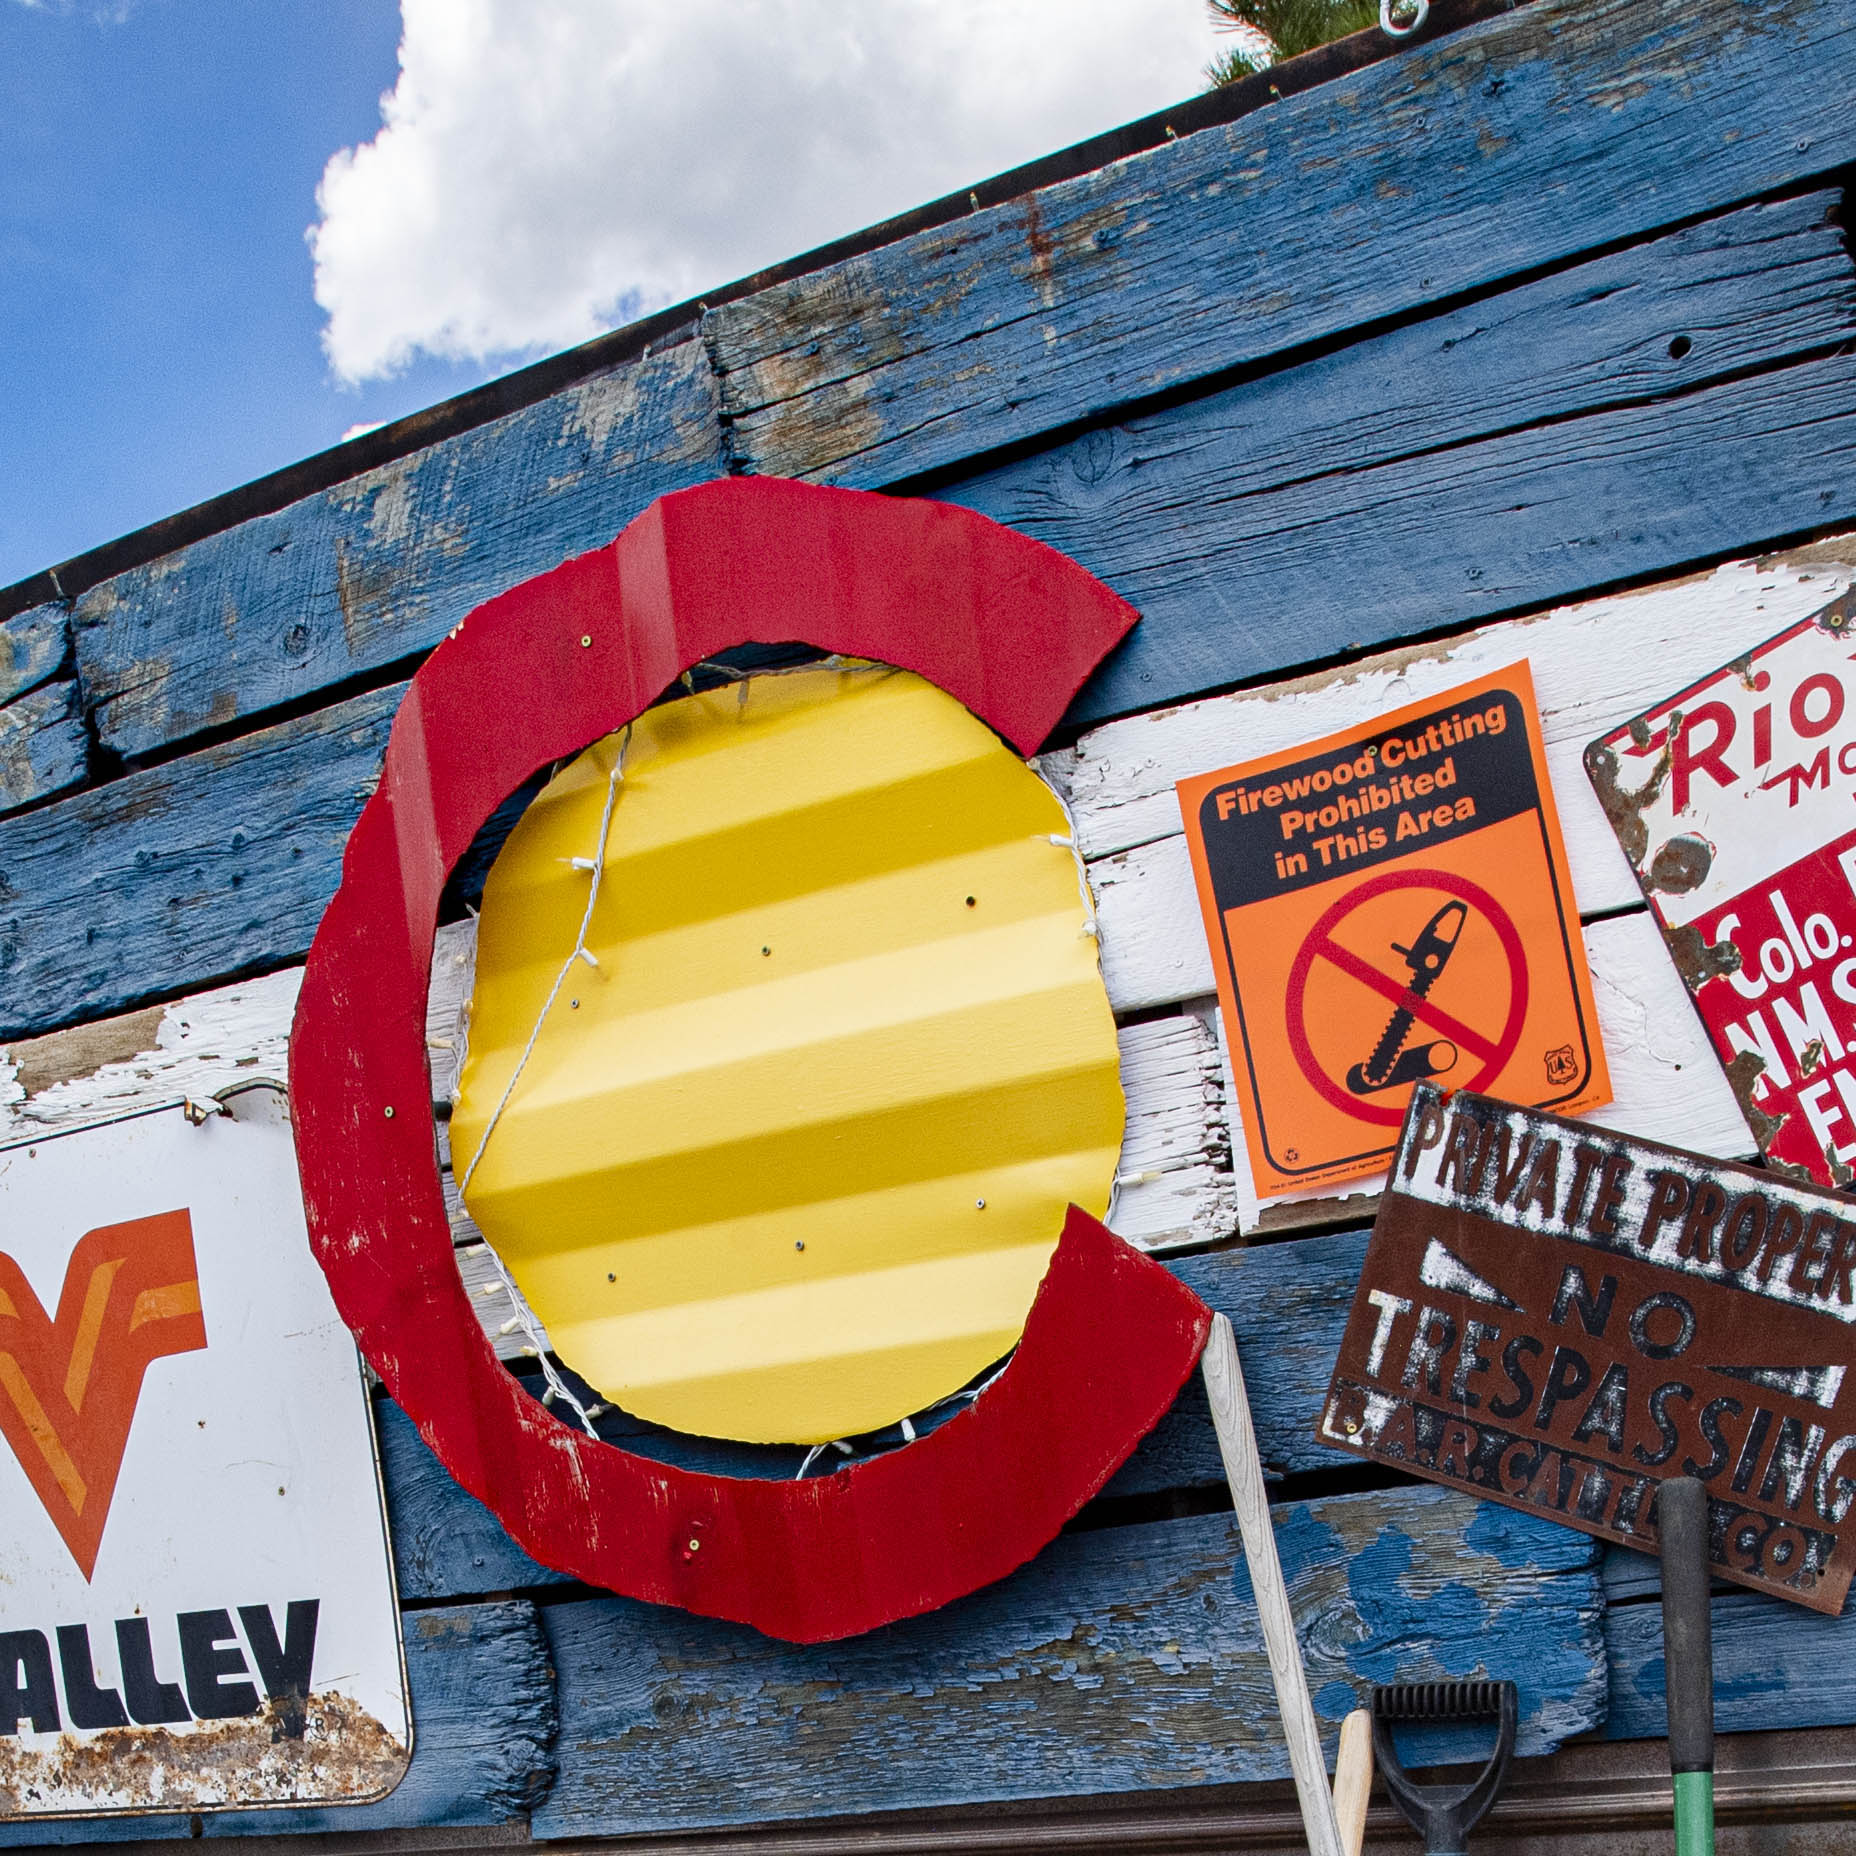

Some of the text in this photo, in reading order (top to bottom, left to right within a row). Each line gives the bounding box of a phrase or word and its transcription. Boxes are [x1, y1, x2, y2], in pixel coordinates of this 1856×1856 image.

[1215, 701, 1508, 821] Firewood Cutting
[1622, 668, 1845, 817] Rio
[1274, 796, 1477, 880] in This Area
[1280, 756, 1457, 839] Prohibited
[1716, 888, 1852, 999] Colo.
[1410, 1105, 1630, 1240] PRIVATE
[1548, 1264, 1697, 1360] NO
[1499, 1440, 1662, 1536] CATTL
